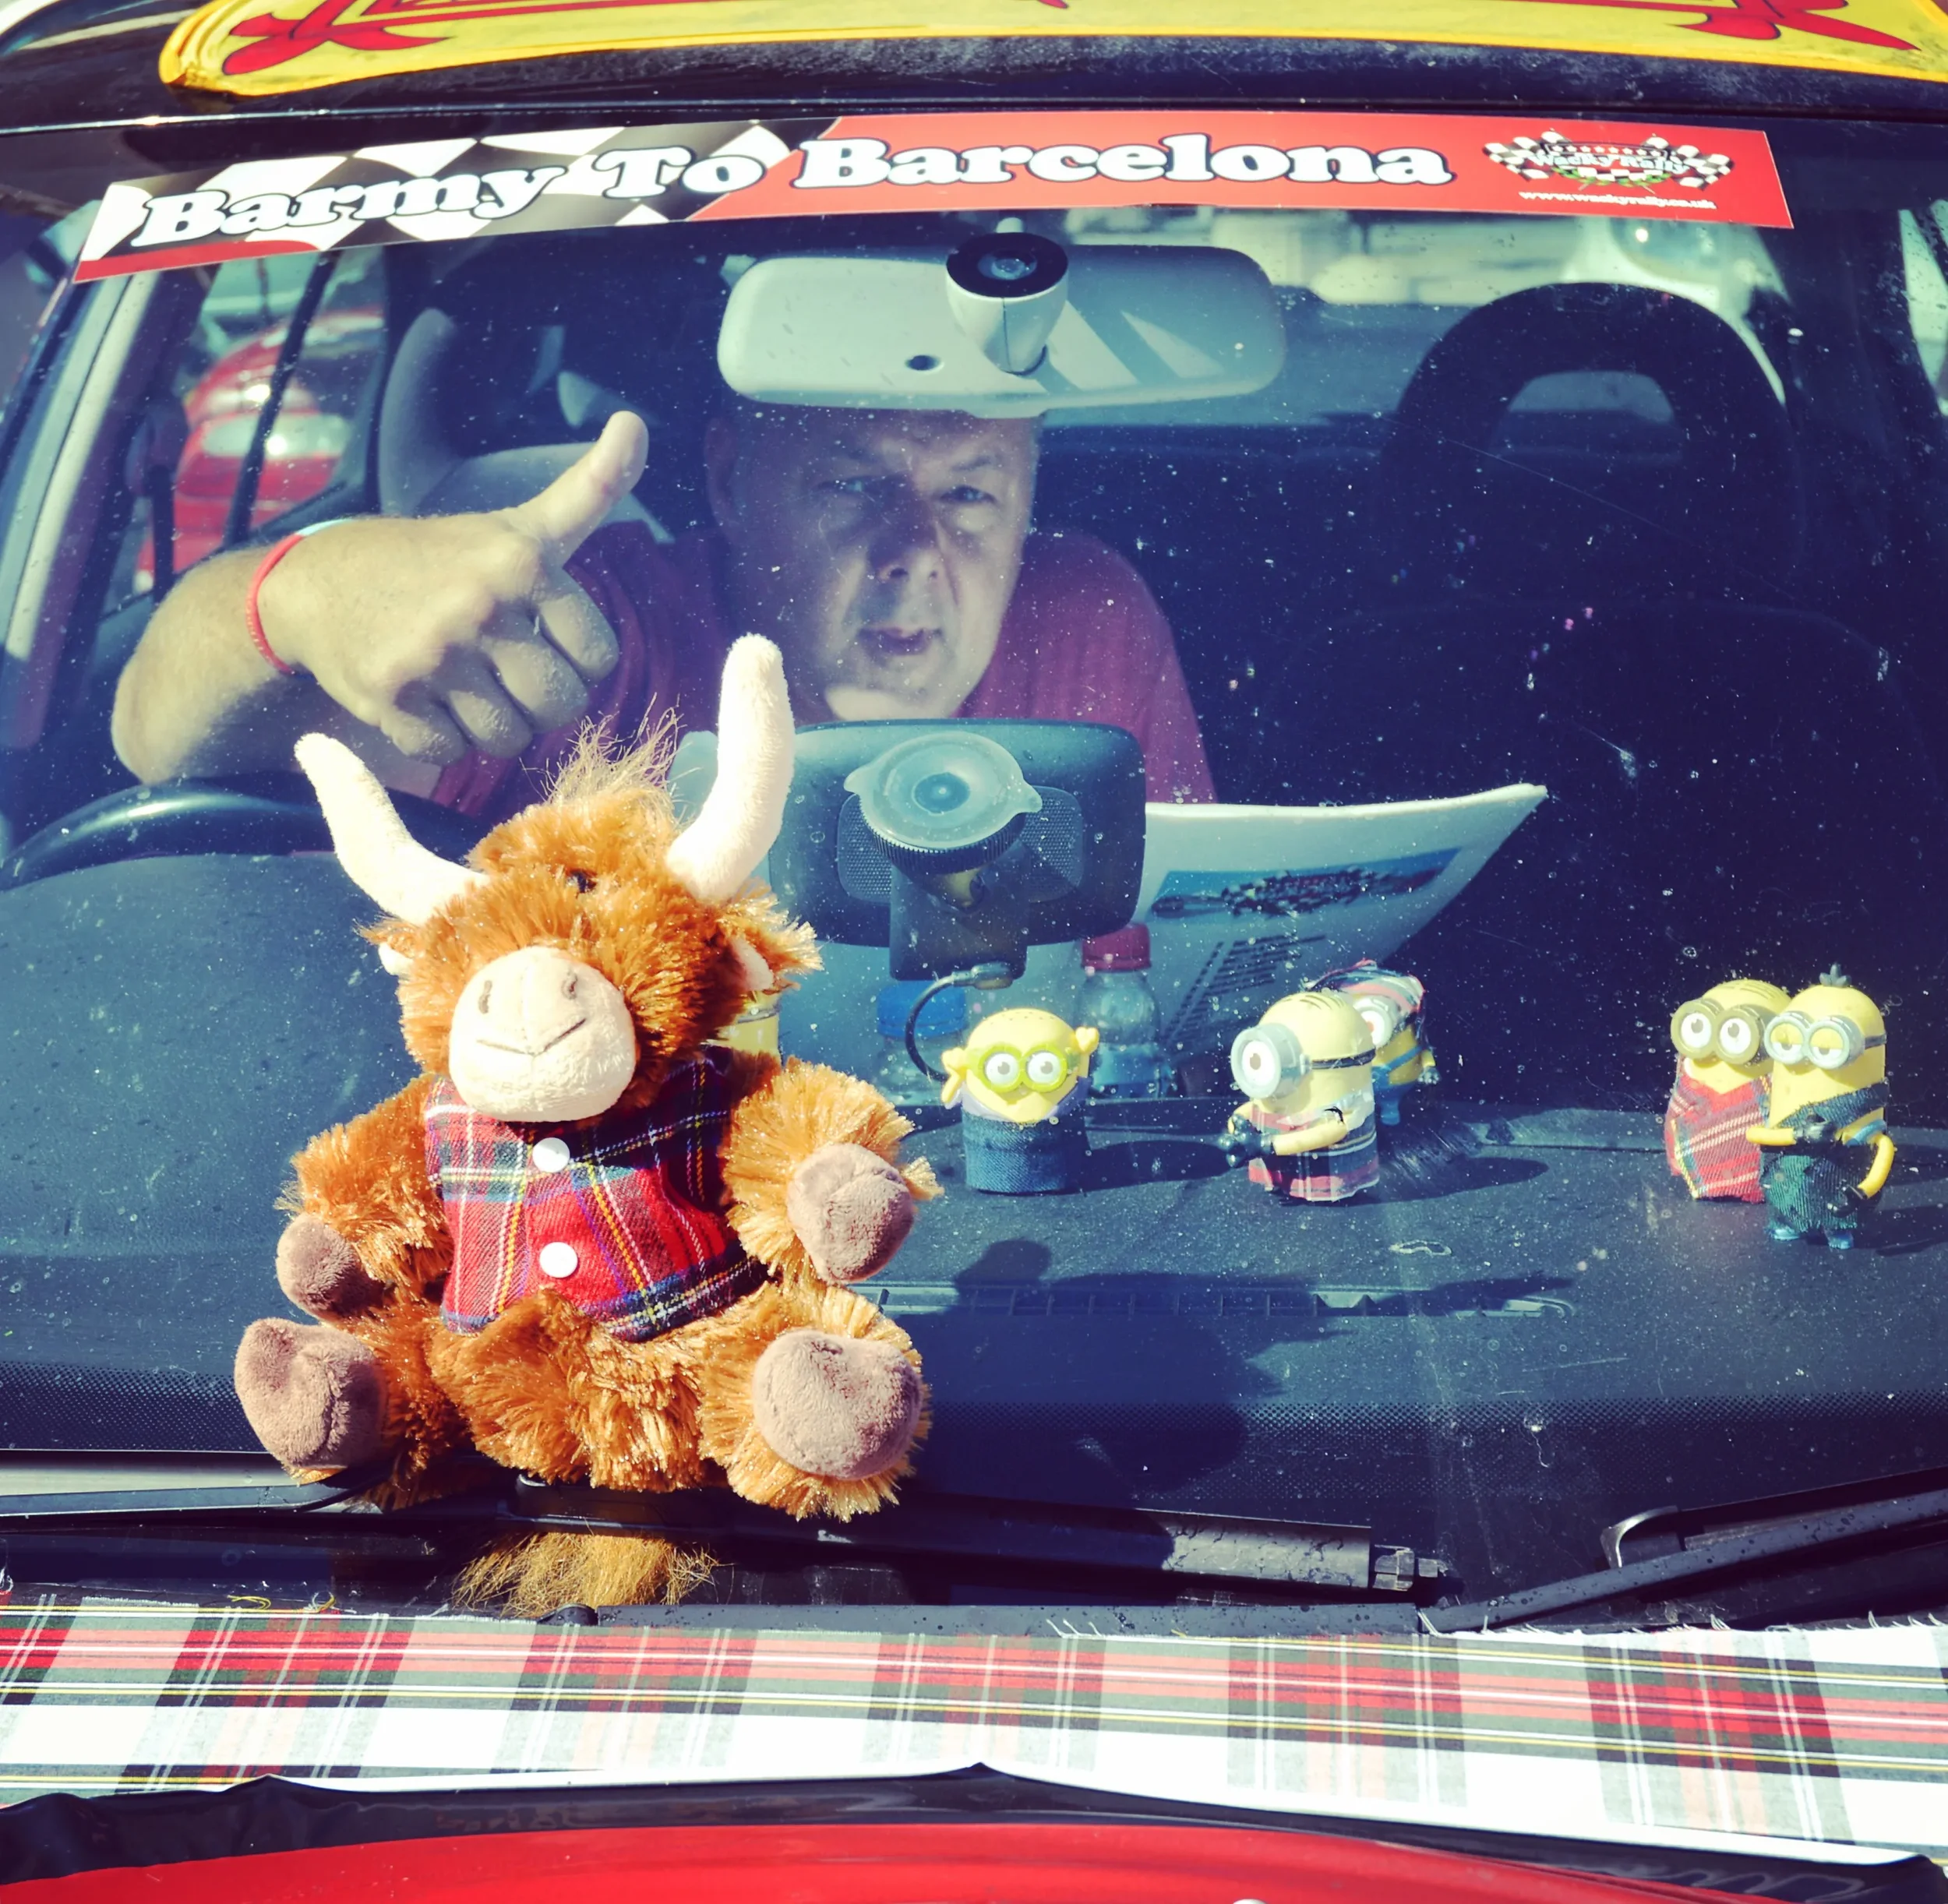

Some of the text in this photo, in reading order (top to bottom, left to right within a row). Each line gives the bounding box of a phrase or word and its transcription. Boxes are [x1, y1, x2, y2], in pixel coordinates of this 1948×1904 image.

[1526, 151, 1690, 175] Wacky Rally
[130, 132, 1457, 249] Barmy To Barcelona
[1519, 191, 1717, 210] www.wackyrally.co.uk
